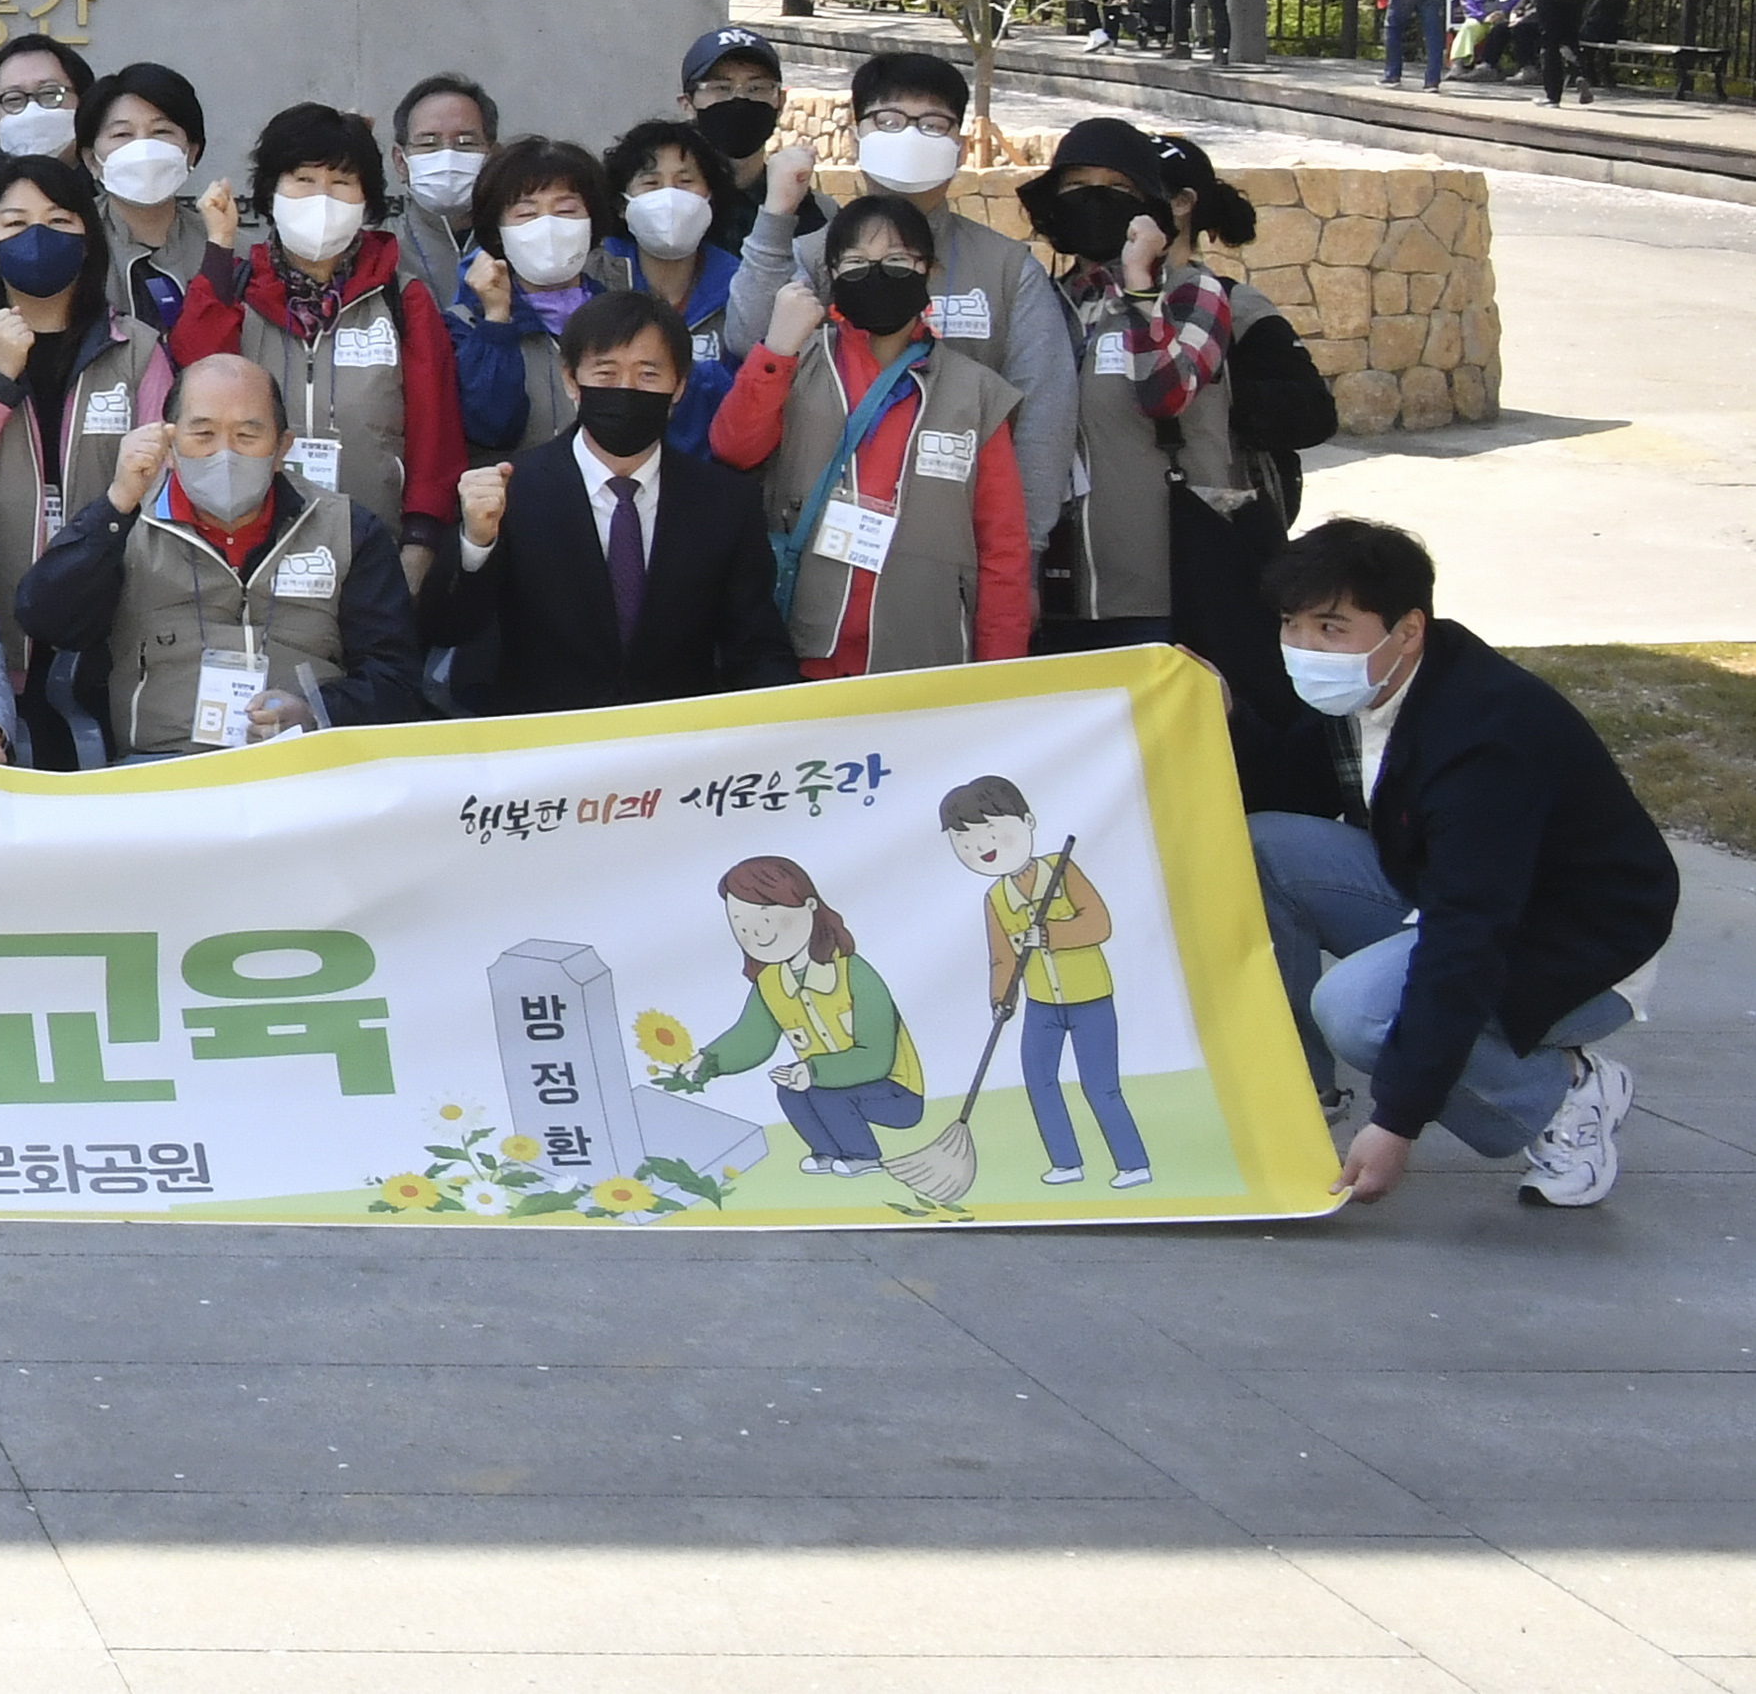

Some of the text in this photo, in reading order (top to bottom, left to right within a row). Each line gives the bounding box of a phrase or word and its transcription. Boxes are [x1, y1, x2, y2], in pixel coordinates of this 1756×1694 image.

[717, 29, 756, 46] NY
[460, 794, 568, 845] 행복한
[576, 788, 662, 825] 미래
[680, 770, 789, 817] 새로운
[519, 992, 593, 1168] 방정환
